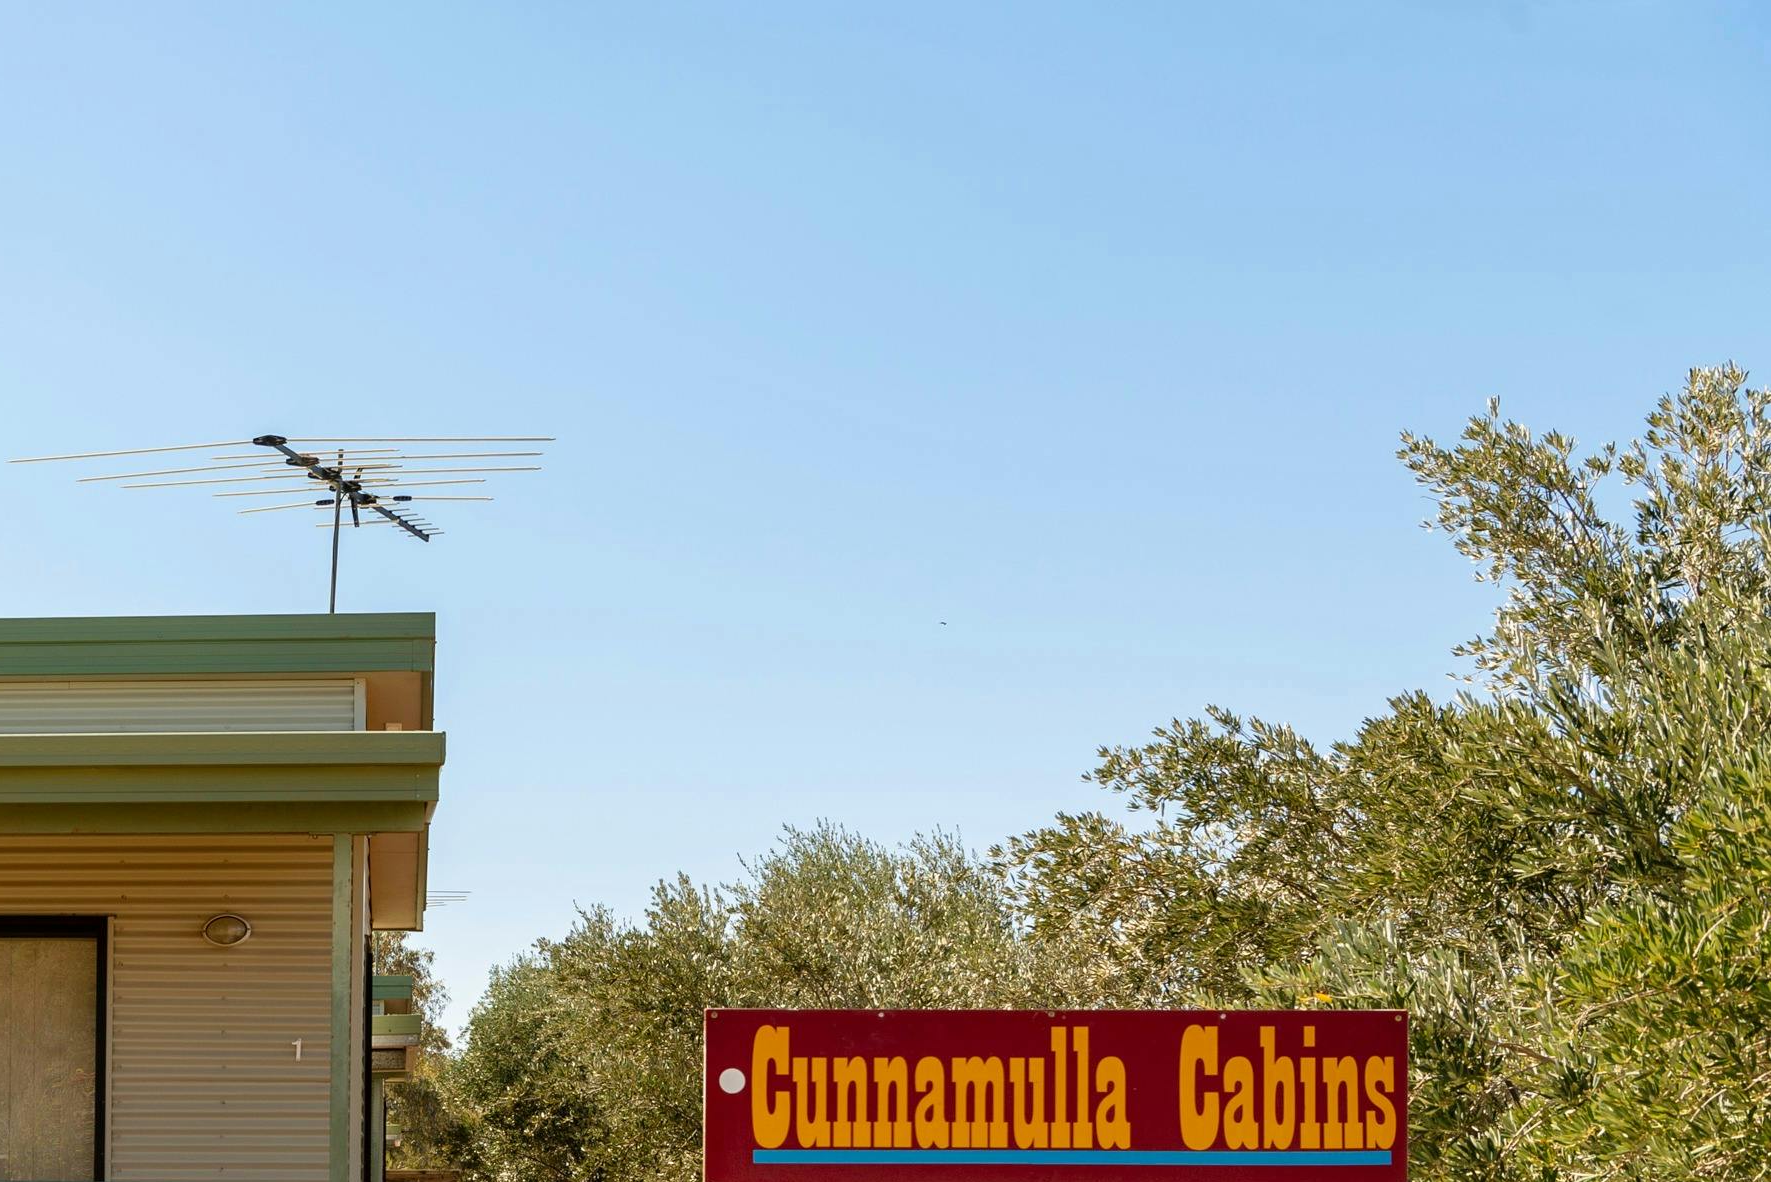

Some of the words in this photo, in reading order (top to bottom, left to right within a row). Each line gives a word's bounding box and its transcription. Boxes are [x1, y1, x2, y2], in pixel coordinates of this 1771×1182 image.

[291, 1037, 302, 1062] 1
[751, 1024, 1131, 1150] Cunnamulla
[1179, 1024, 1397, 1151] Cabins
